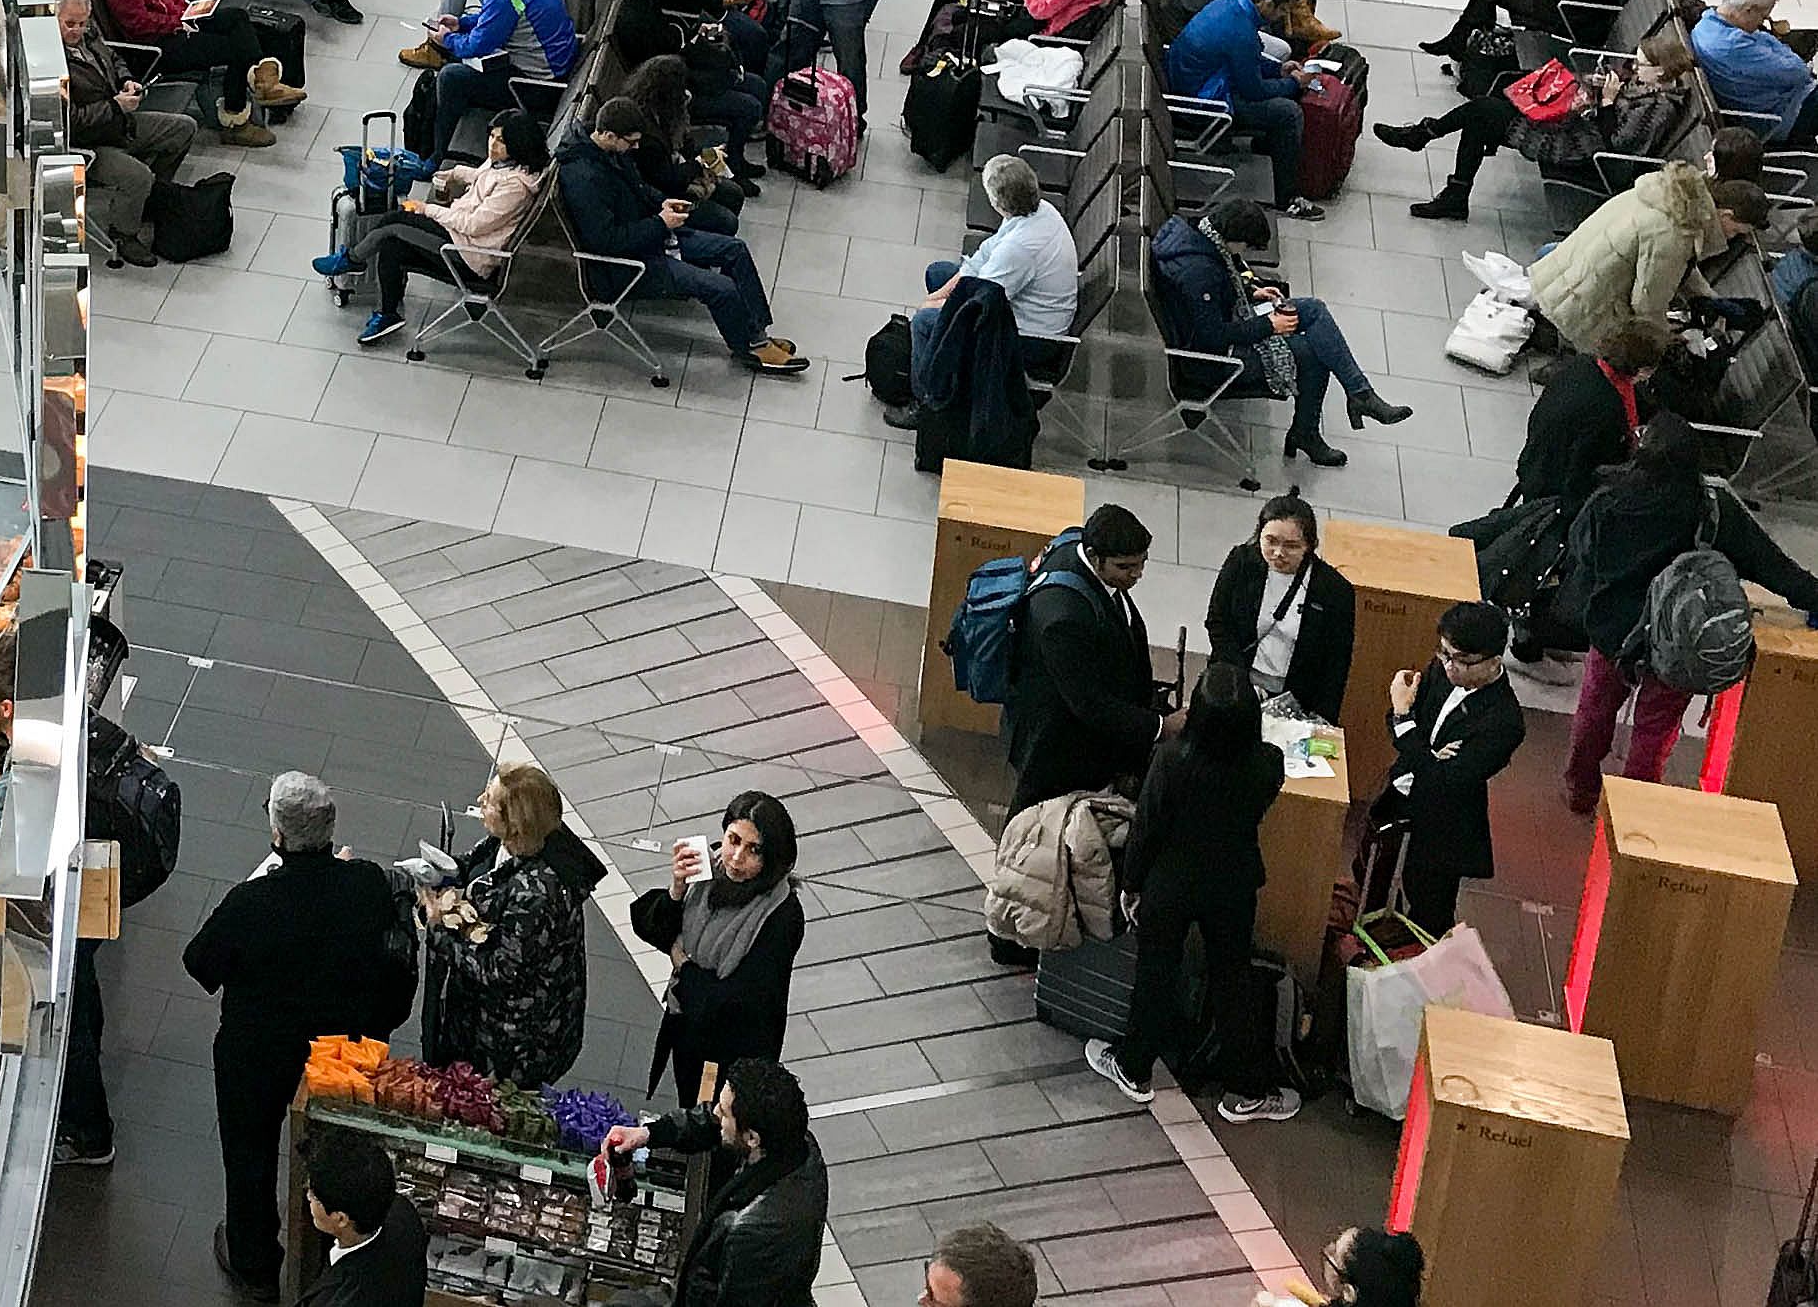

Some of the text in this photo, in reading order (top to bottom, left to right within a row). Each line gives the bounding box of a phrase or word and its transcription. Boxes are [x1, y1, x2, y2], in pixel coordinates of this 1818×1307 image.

[970, 535, 1013, 552] Refuel
[1363, 598, 1407, 615] Refuel
[1658, 876, 1708, 894] Refuel
[1479, 1125, 1533, 1148] Refuel
